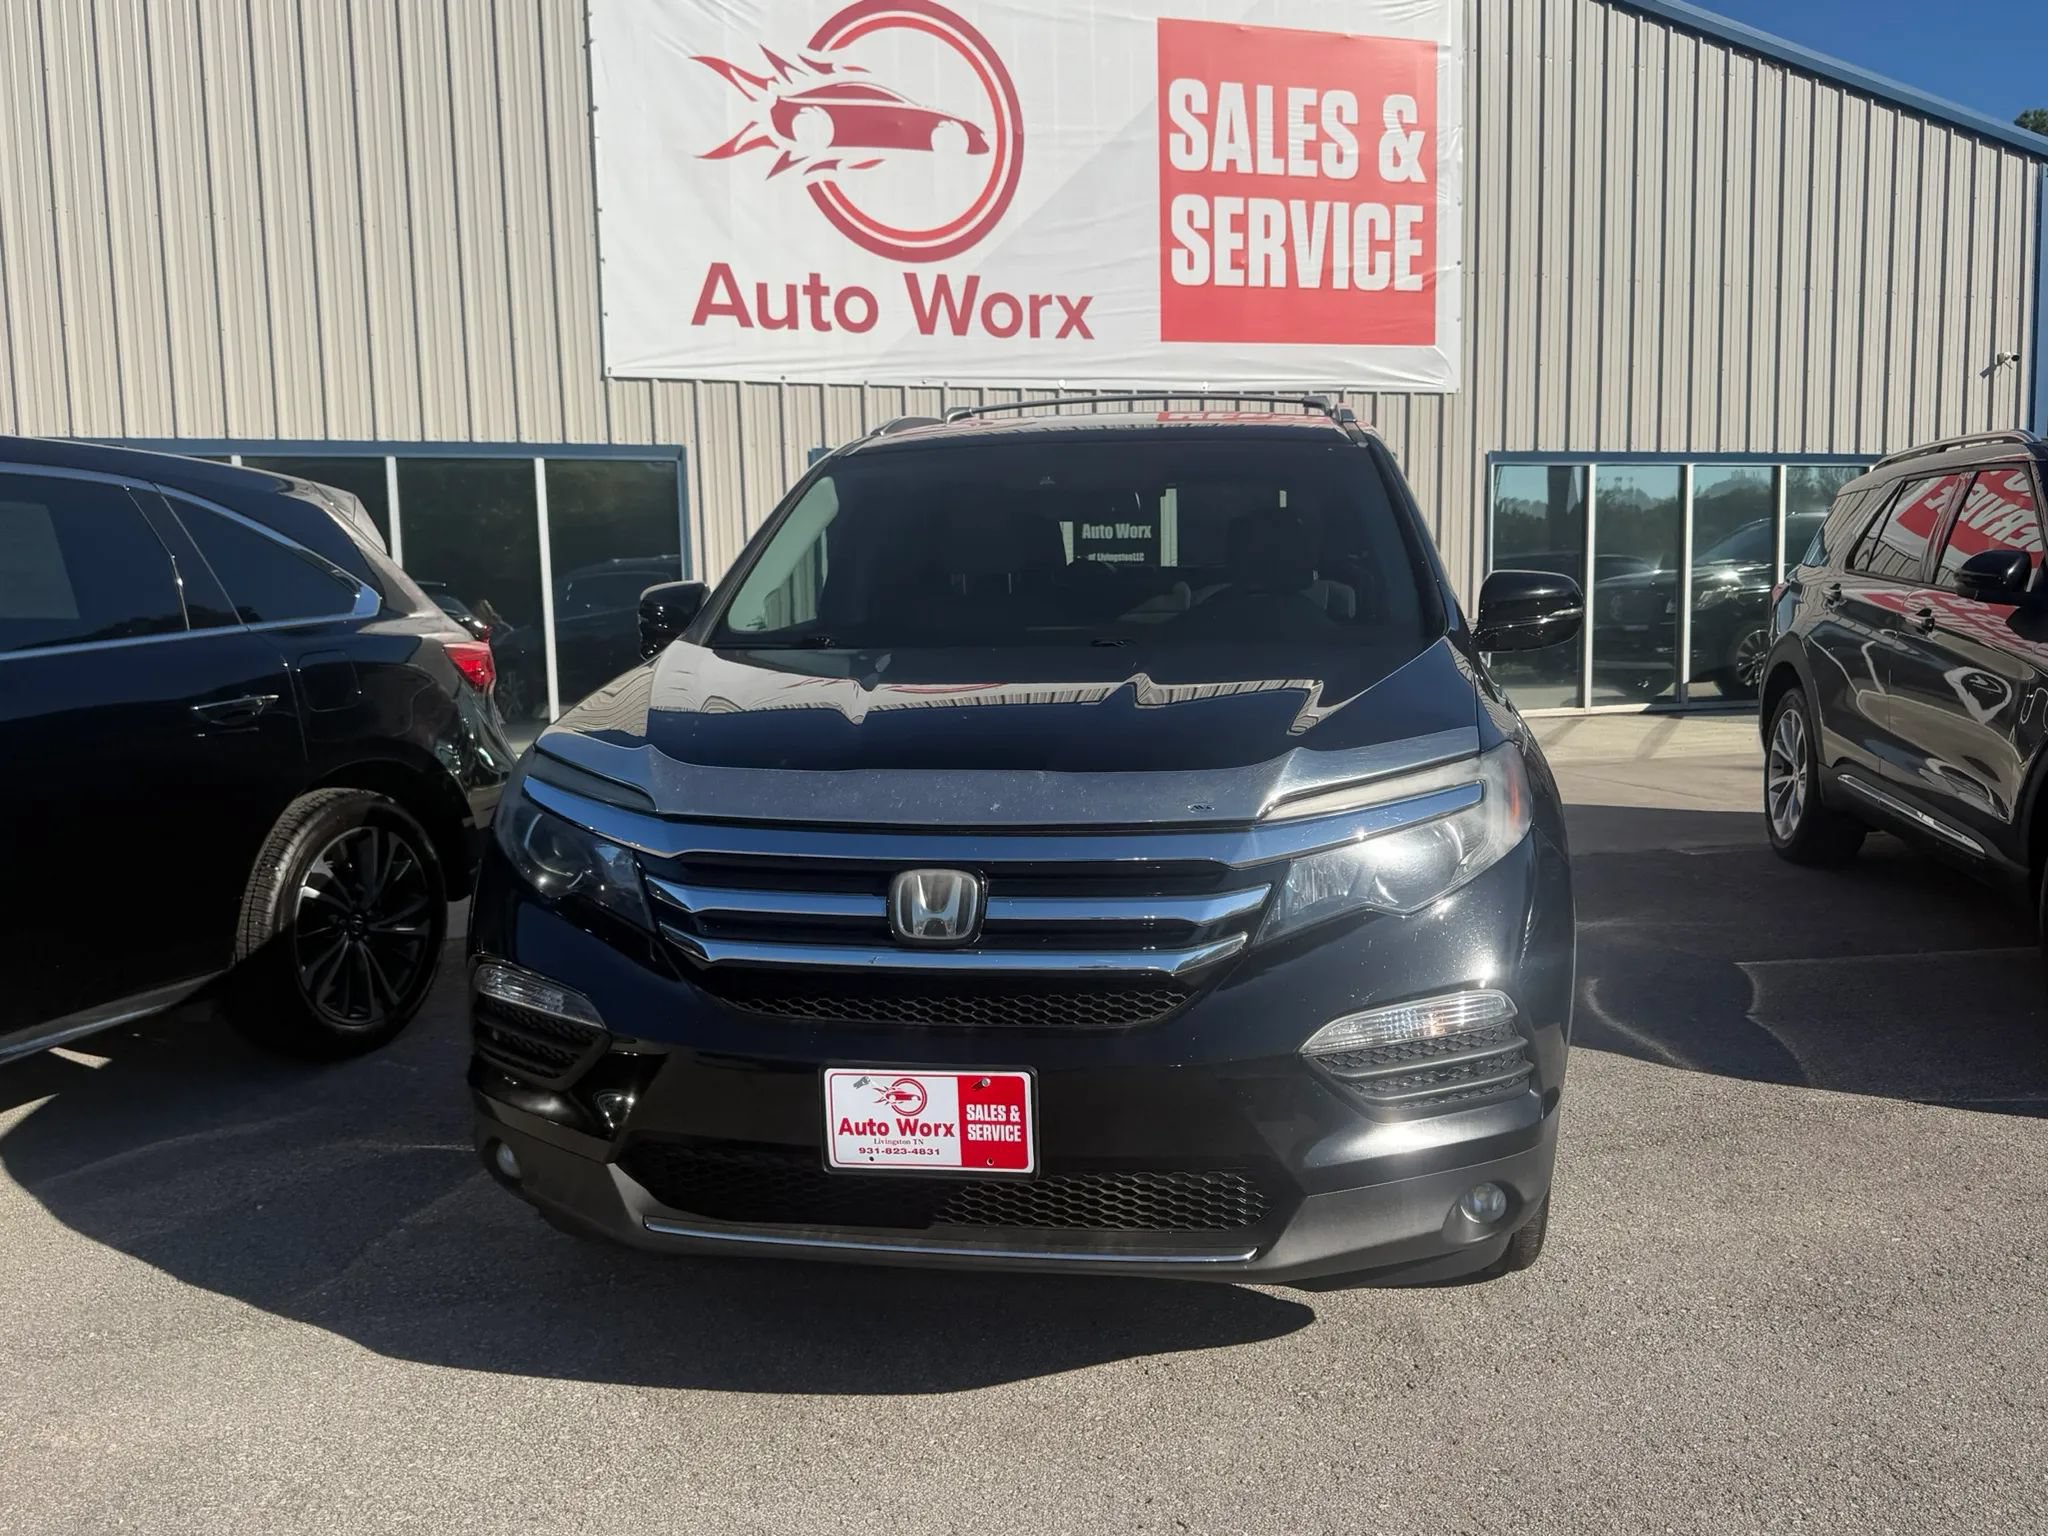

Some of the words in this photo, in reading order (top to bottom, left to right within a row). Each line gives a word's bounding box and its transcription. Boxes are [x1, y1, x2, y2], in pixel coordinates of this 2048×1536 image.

[1168, 77, 1359, 180] SALES
[1378, 94, 1428, 183] &
[1170, 193, 1424, 292] SERVICE
[690, 262, 880, 334] Auto
[902, 272, 1095, 340] Worx
[1082, 523, 1113, 539] Auto
[1115, 523, 1152, 539] Worx
[966, 1103, 1007, 1122] SALES
[1009, 1105, 1021, 1123] &
[838, 1117, 890, 1137] Auto
[895, 1118, 955, 1138] Worx
[967, 1124, 1022, 1142] SERVICE
[873, 1138, 911, 1146] Livingston
